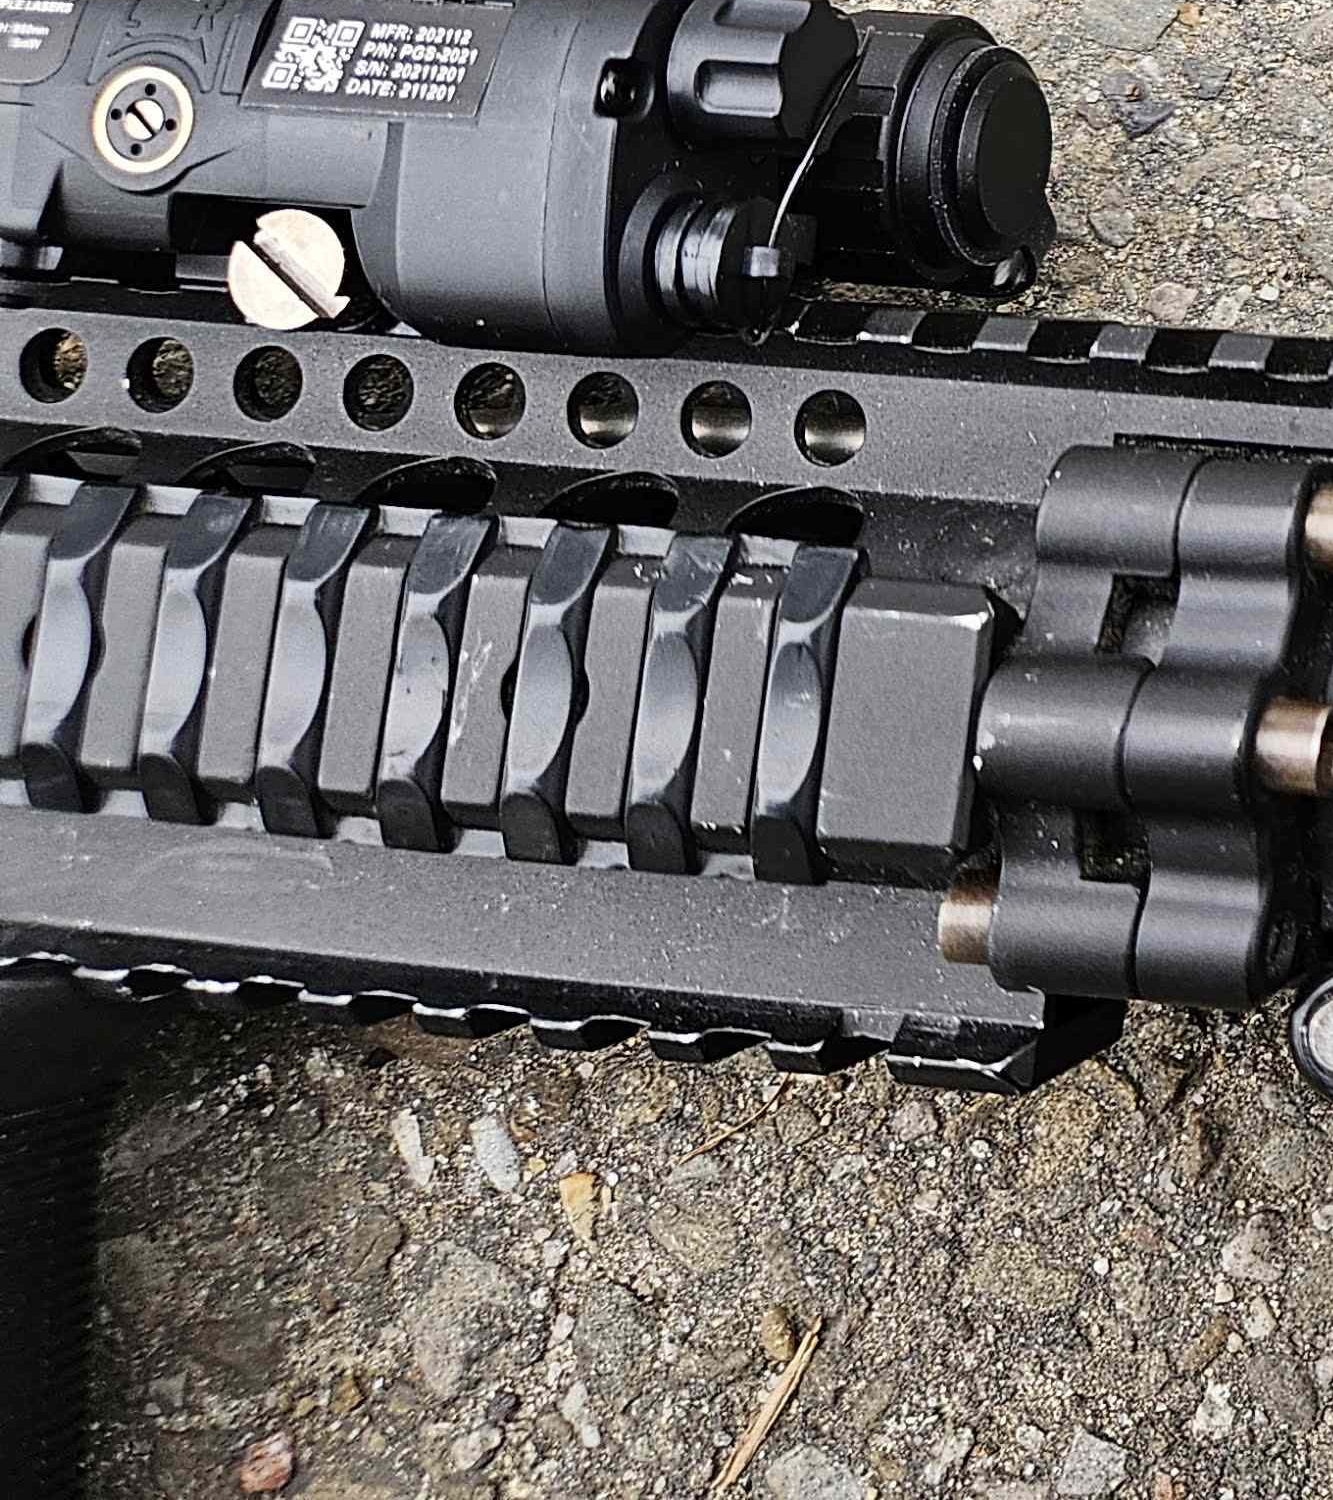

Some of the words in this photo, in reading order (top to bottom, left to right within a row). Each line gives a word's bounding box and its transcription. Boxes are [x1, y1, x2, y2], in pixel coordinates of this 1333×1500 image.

[370, 23, 413, 41] MFR:
[415, 26, 473, 45] 202112
[362, 41, 397, 59] P/N:
[354, 59, 390, 77] S/N:
[391, 62, 466, 84] 20211201
[345, 77, 397, 98] DATE:
[399, 81, 456, 103] 211201
